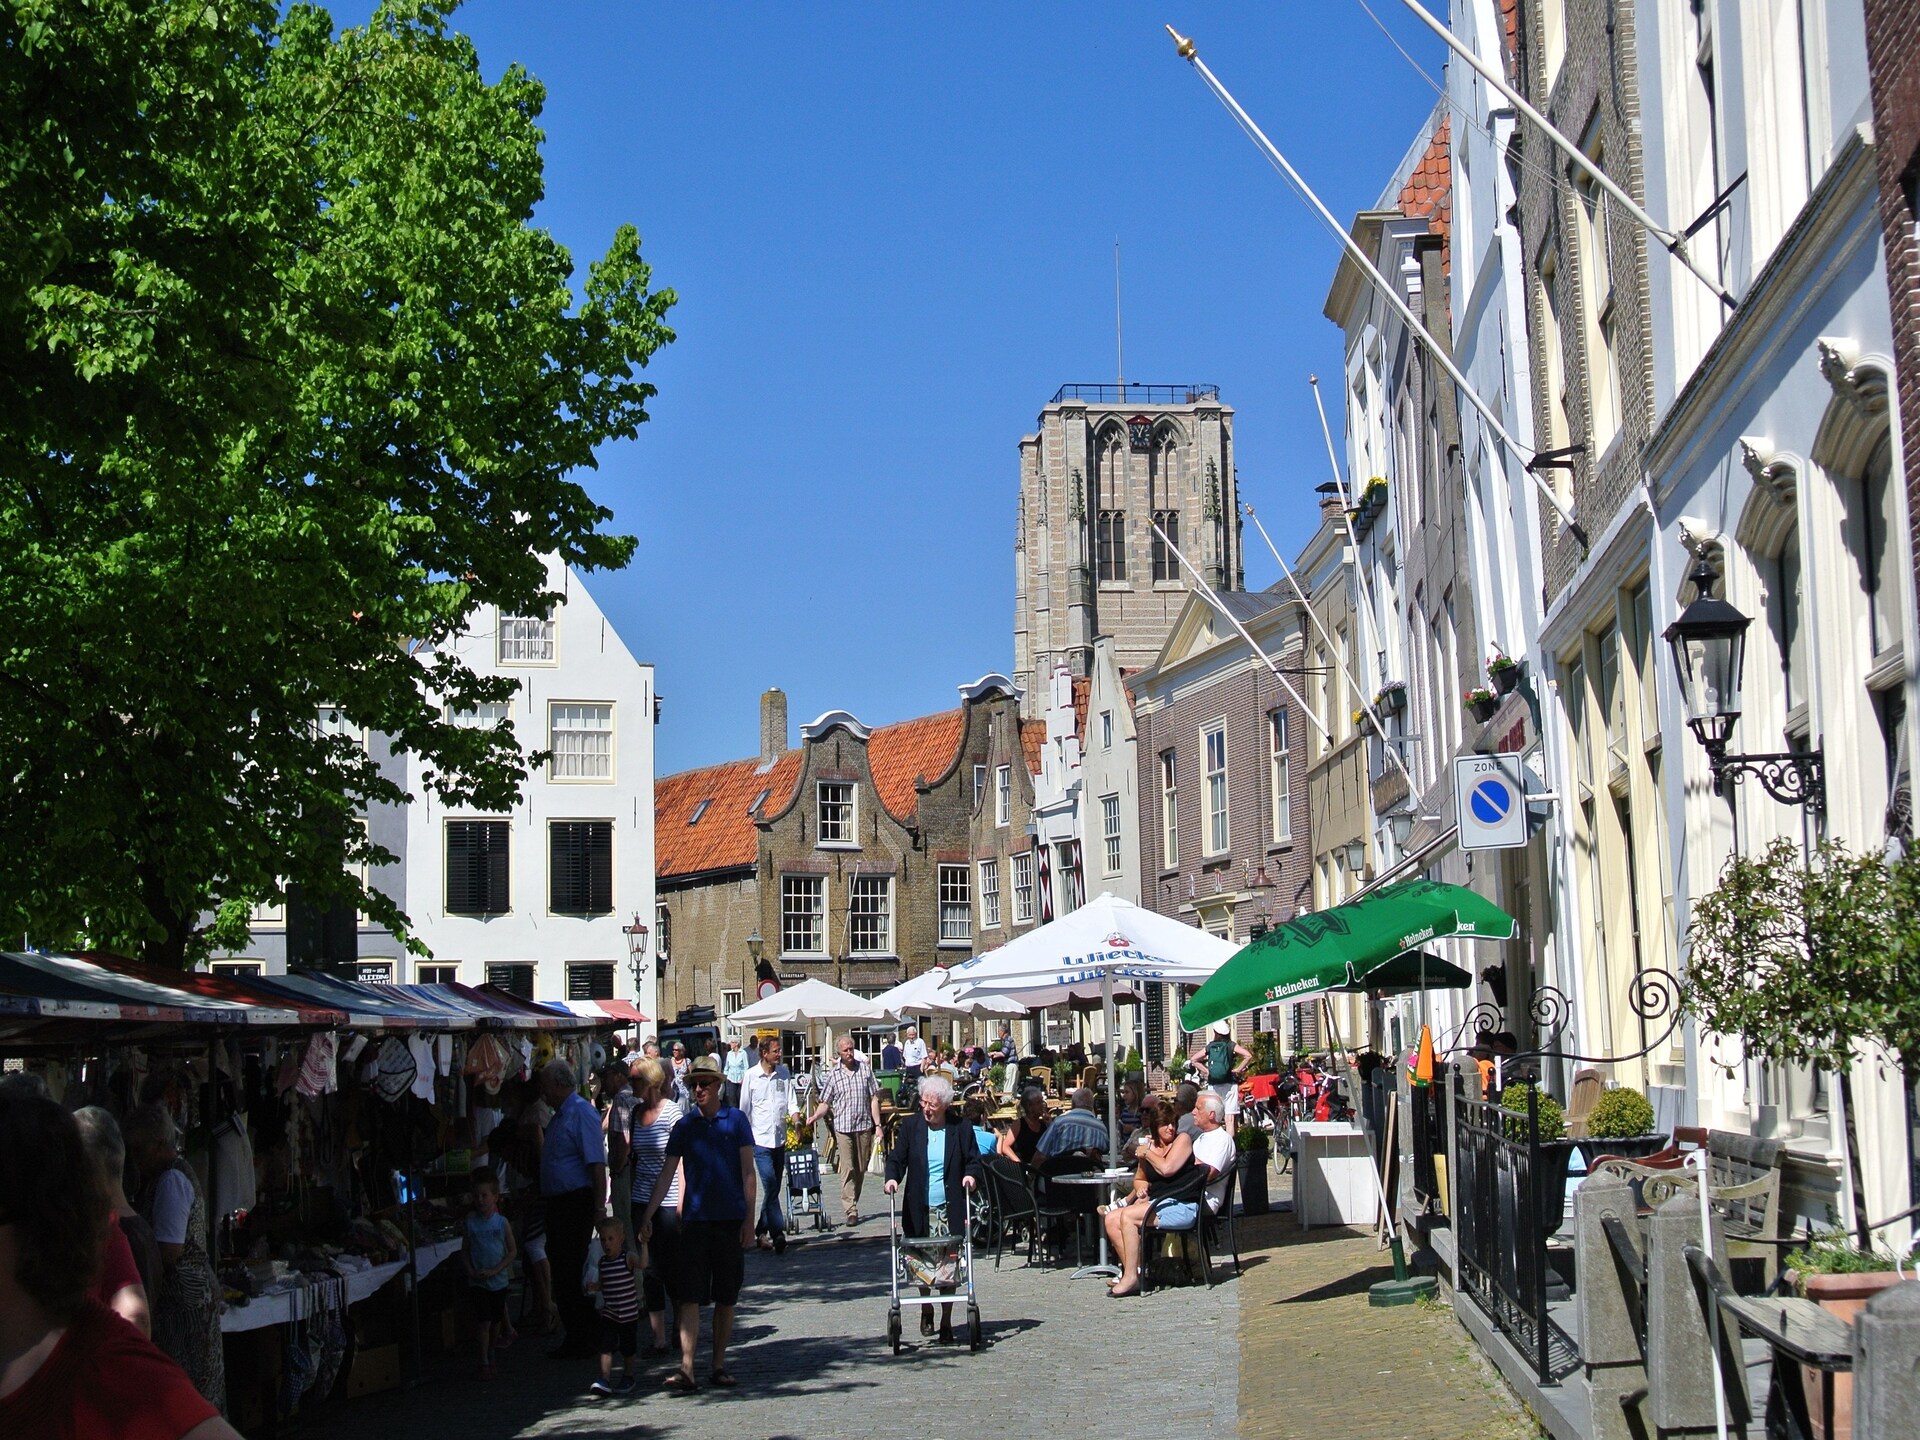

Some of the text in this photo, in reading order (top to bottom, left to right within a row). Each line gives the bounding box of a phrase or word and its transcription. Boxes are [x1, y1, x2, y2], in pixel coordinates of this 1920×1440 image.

[1474, 762, 1503, 773] ZONE
[1404, 927, 1434, 947] Heineken
[1057, 968, 1163, 984] Wiekse
[1274, 977, 1319, 997] Heineken
